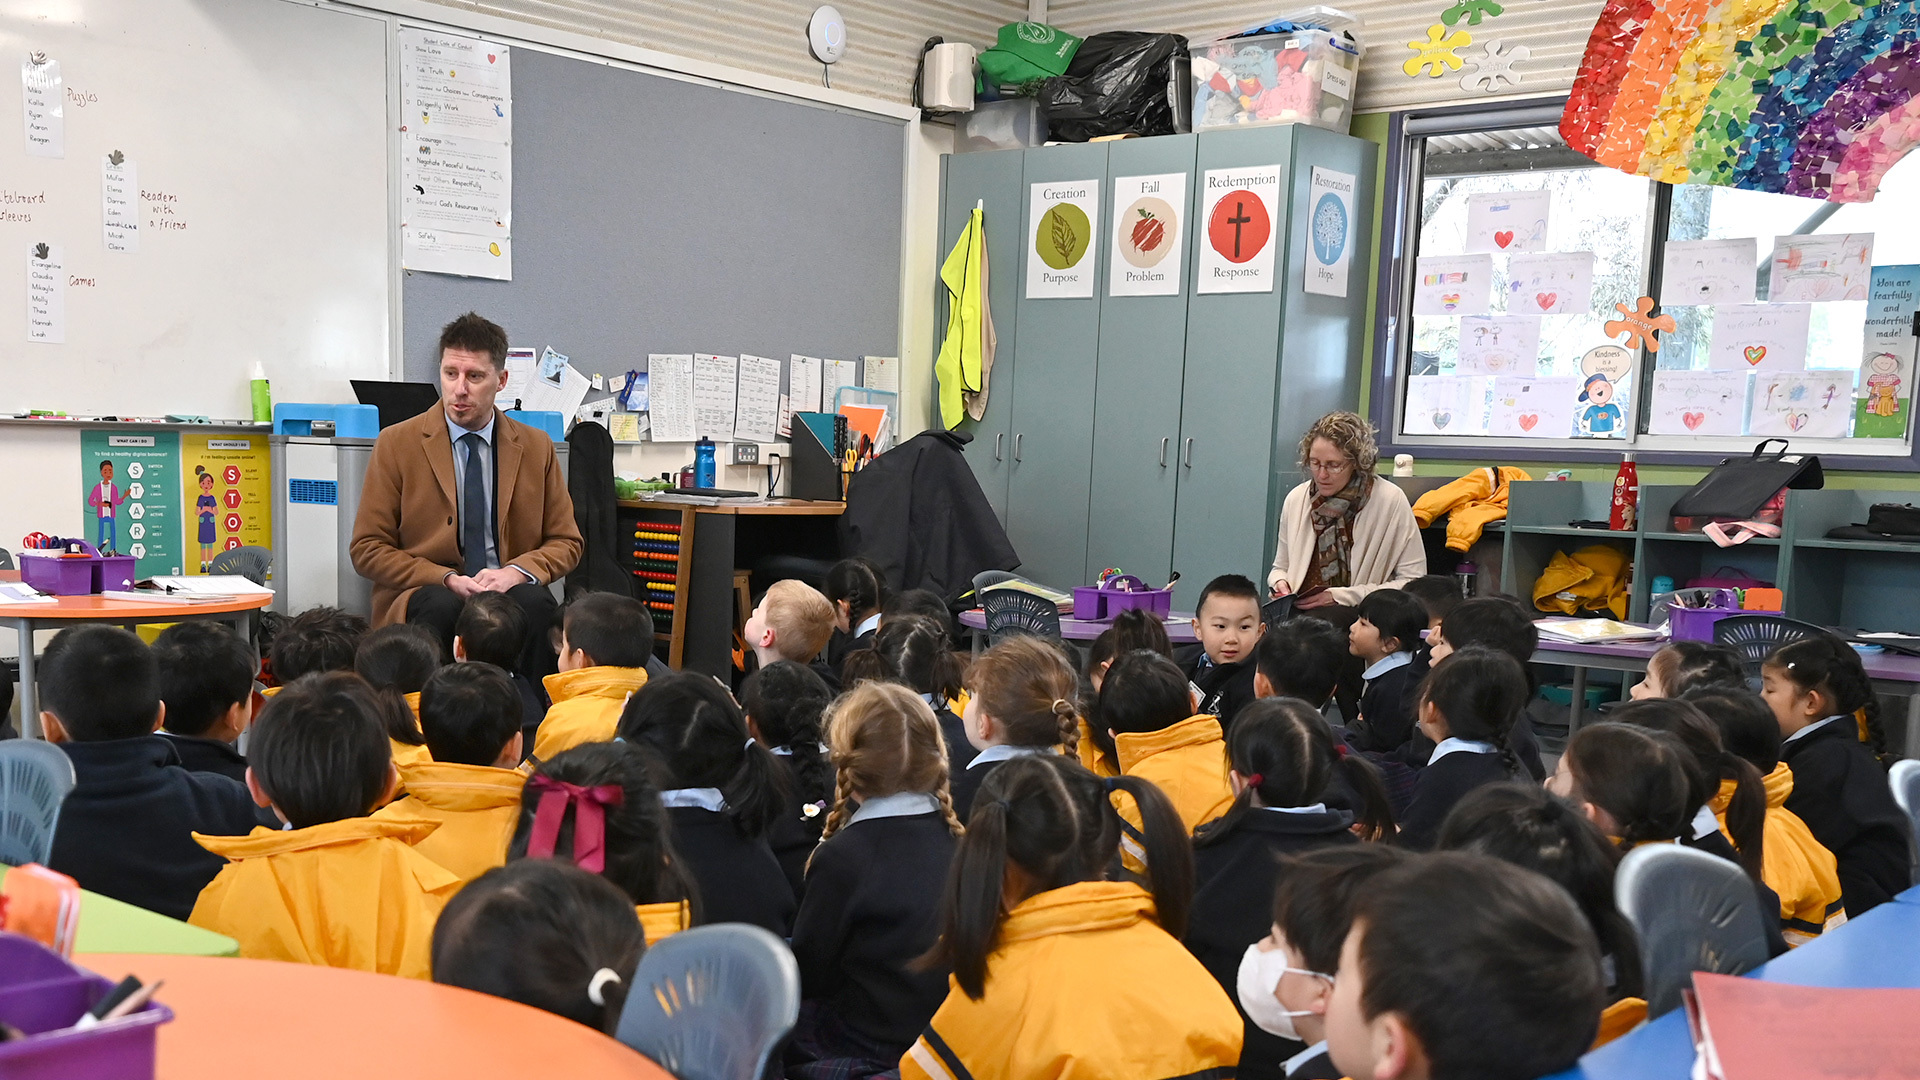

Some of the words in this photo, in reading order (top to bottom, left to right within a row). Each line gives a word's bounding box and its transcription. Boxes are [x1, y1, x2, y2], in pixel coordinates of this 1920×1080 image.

[428, 46, 441, 55] Love
[1421, 46, 1451, 57] yellow
[429, 66, 445, 75] Truth
[1480, 61, 1508, 72] white
[1326, 71, 1339, 84] Dress
[67, 87, 98, 108] Puzzles
[443, 86, 461, 95] Choices
[471, 90, 504, 102] Consequences
[417, 99, 442, 112] Diligently
[443, 103, 459, 111] Work
[28, 110, 43, 120] Ryan
[30, 122, 48, 131] Aaron
[30, 134, 50, 145] Reagan
[416, 133, 442, 146] Encourage
[416, 157, 440, 167] Negotiate
[442, 160, 463, 169] Peaceful
[452, 178, 482, 191] Respectfully
[1209, 173, 1276, 189] Redemption
[1315, 174, 1351, 192] Restoration
[1141, 181, 1160, 193] Fall
[140, 190, 178, 202] Readers
[1043, 187, 1086, 200] Creation
[153, 204, 174, 214] with
[439, 200, 453, 208] God's
[455, 202, 478, 211] Resources
[160, 218, 186, 230] friend
[32, 272, 54, 280] Claudia
[1043, 273, 1078, 285] Purpose
[1126, 271, 1164, 282] Problem
[1213, 267, 1260, 280] Response
[1318, 268, 1334, 282] Hope
[1876, 278, 1895, 287] You
[32, 295, 49, 305] Molly
[1874, 291, 1912, 302] fearfully
[32, 307, 47, 315] Thea
[1884, 304, 1900, 313] and
[32, 319, 52, 327] Hannah
[1626, 316, 1653, 331] orange
[1876, 329, 1902, 338] made!
[132, 466, 139, 475] S
[228, 469, 236, 480] S
[133, 486, 139, 495] T
[228, 493, 236, 504] T
[133, 507, 140, 515] A
[228, 517, 238, 528] O
[134, 527, 140, 535] R
[135, 547, 140, 555] T
[230, 541, 237, 550] P
